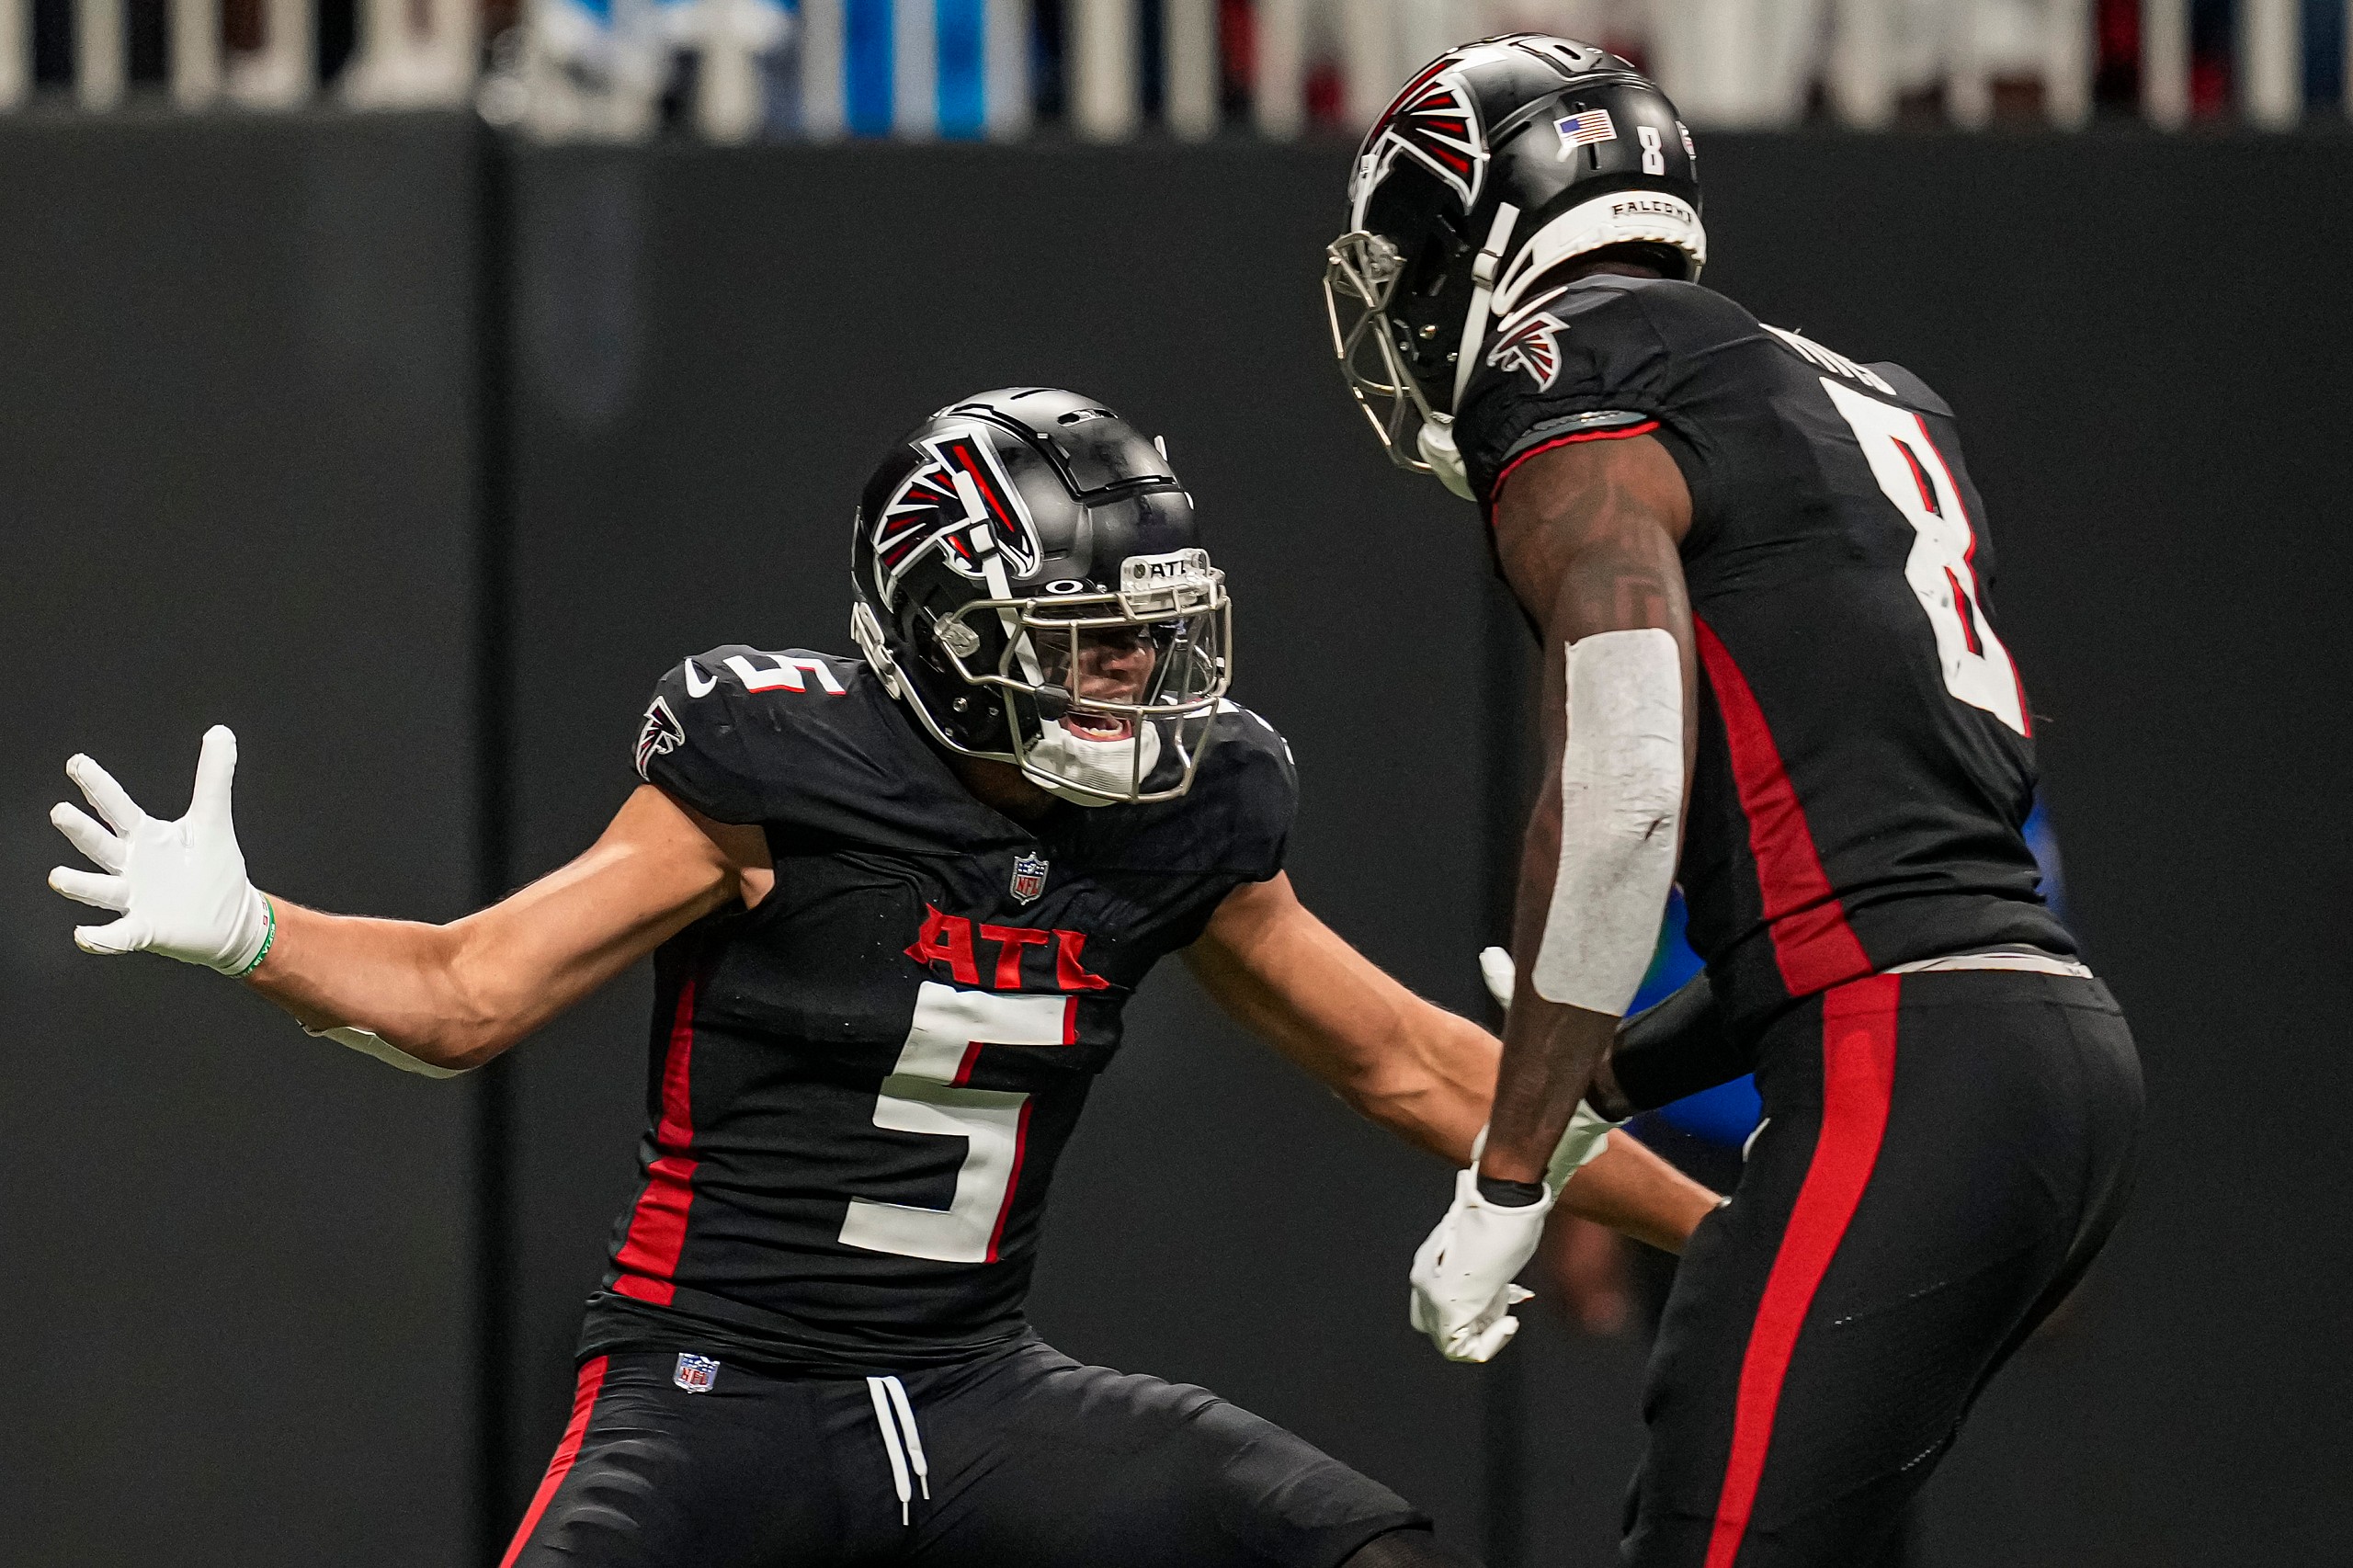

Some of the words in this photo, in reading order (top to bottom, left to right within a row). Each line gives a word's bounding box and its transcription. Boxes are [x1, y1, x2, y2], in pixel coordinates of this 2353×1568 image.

[1636, 125, 1665, 176] 8
[1818, 376, 2031, 739] 8
[722, 653, 847, 696] 5
[903, 903, 1111, 992] ATL
[837, 981, 1078, 1264] 5
